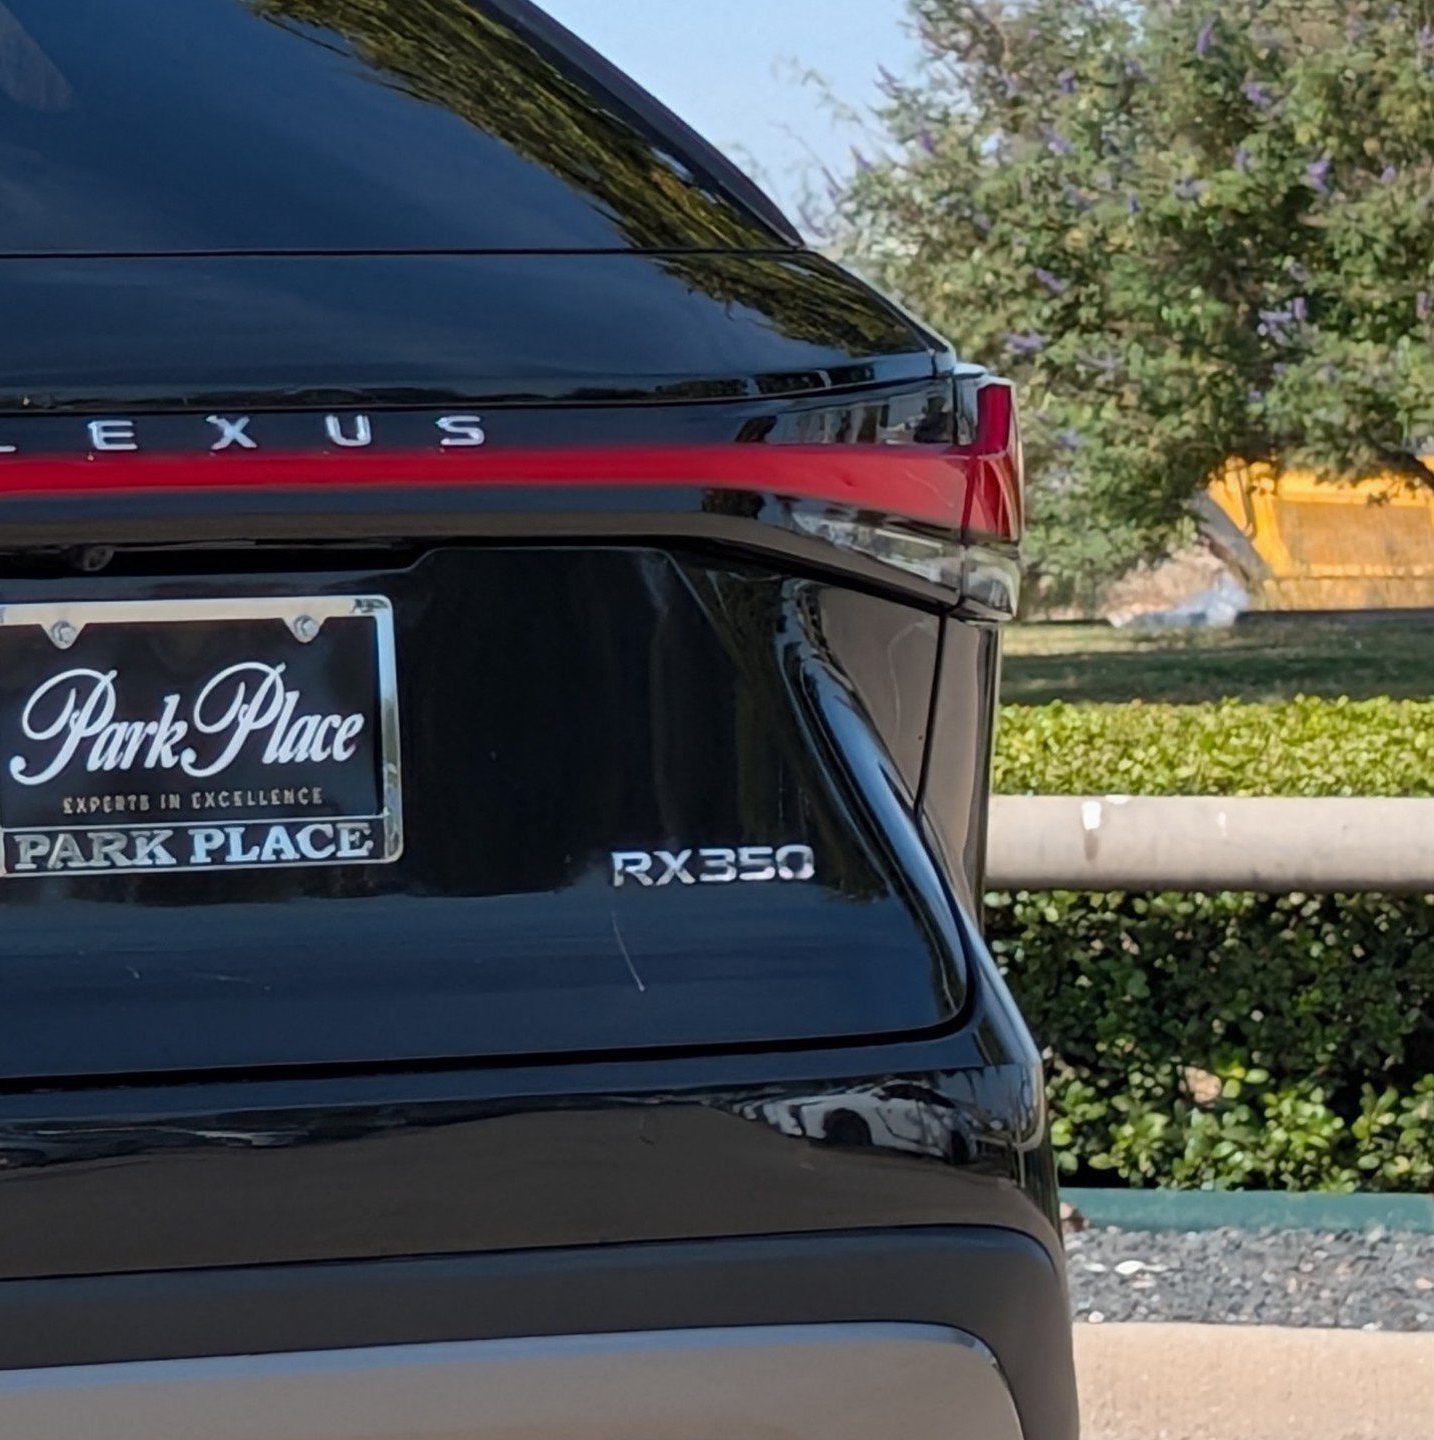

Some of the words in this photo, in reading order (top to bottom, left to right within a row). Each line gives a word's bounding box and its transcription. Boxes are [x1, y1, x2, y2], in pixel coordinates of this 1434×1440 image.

[9, 667, 189, 787] Park
[180, 660, 365, 779] Place
[62, 794, 151, 814] EXPERTS
[160, 793, 181, 810] IN
[190, 786, 324, 810] EXCELLENCE
[13, 829, 178, 871] PARK
[187, 821, 376, 864] PLACE
[610, 843, 816, 888] RX350
